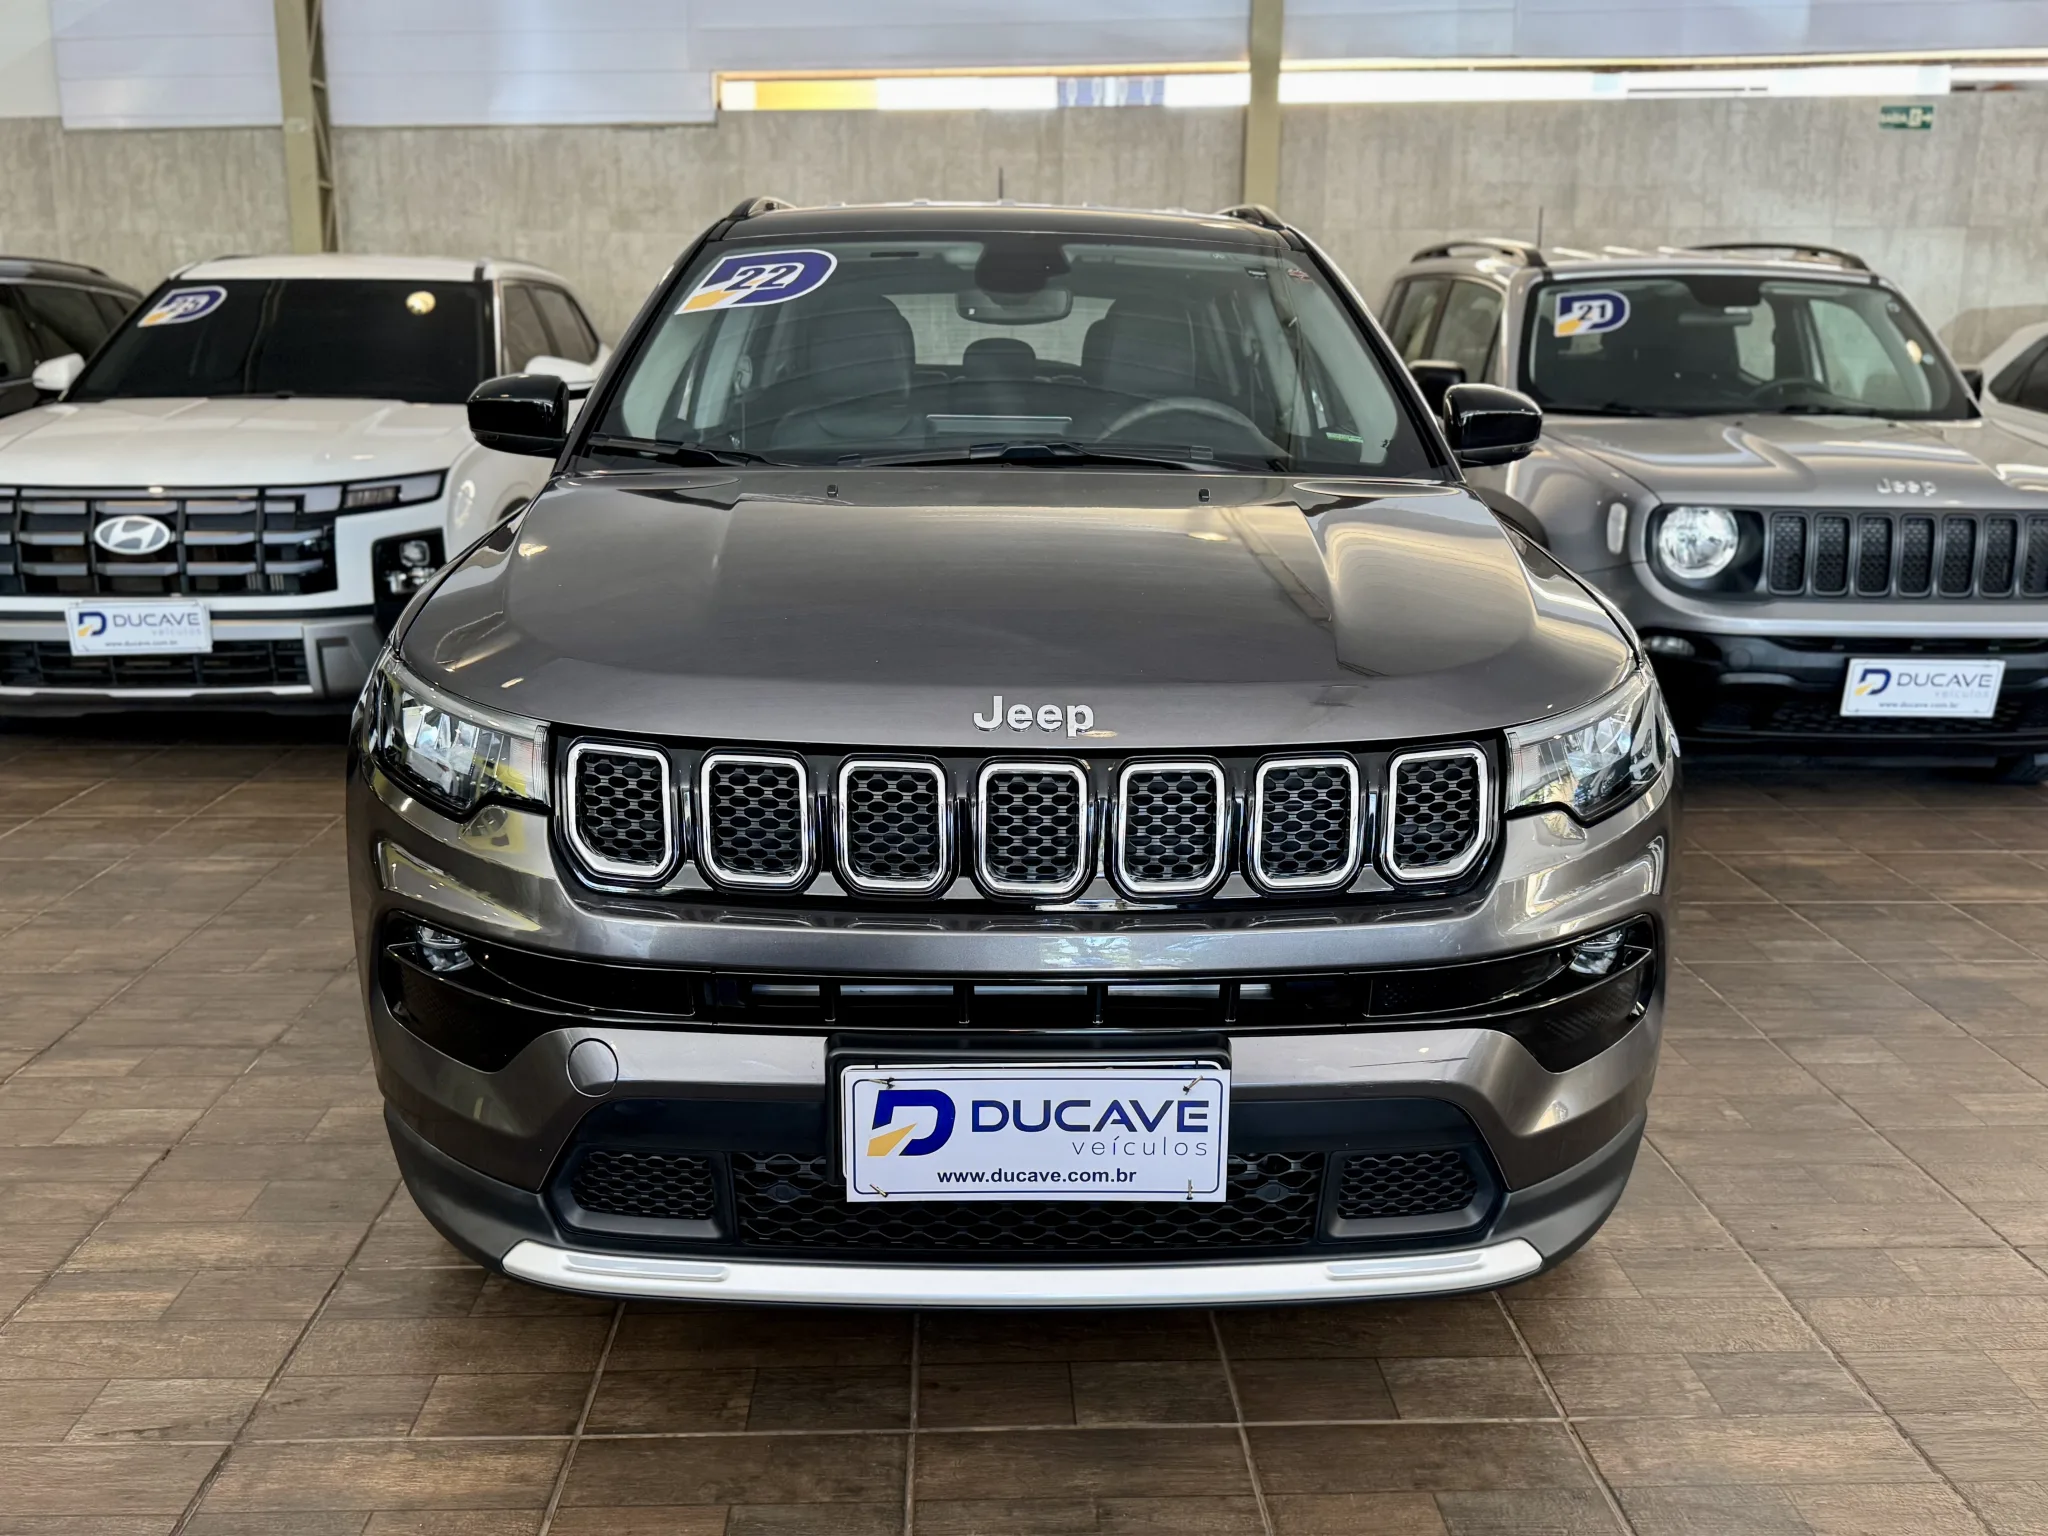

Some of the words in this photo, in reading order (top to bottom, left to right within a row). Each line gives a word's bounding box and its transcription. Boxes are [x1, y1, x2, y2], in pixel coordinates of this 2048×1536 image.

[723, 265, 800, 292] 22
[1577, 303, 1606, 321] 21
[1876, 477, 1937, 497] Jeep
[112, 612, 200, 628] DUCAVE
[1896, 672, 1994, 688] DUCAVE
[972, 695, 1095, 740] Jeep
[971, 1099, 1210, 1133] DUCAVE
[1071, 1135, 1208, 1156] veículos
[936, 1167, 1138, 1184] www.ducave.com.br
